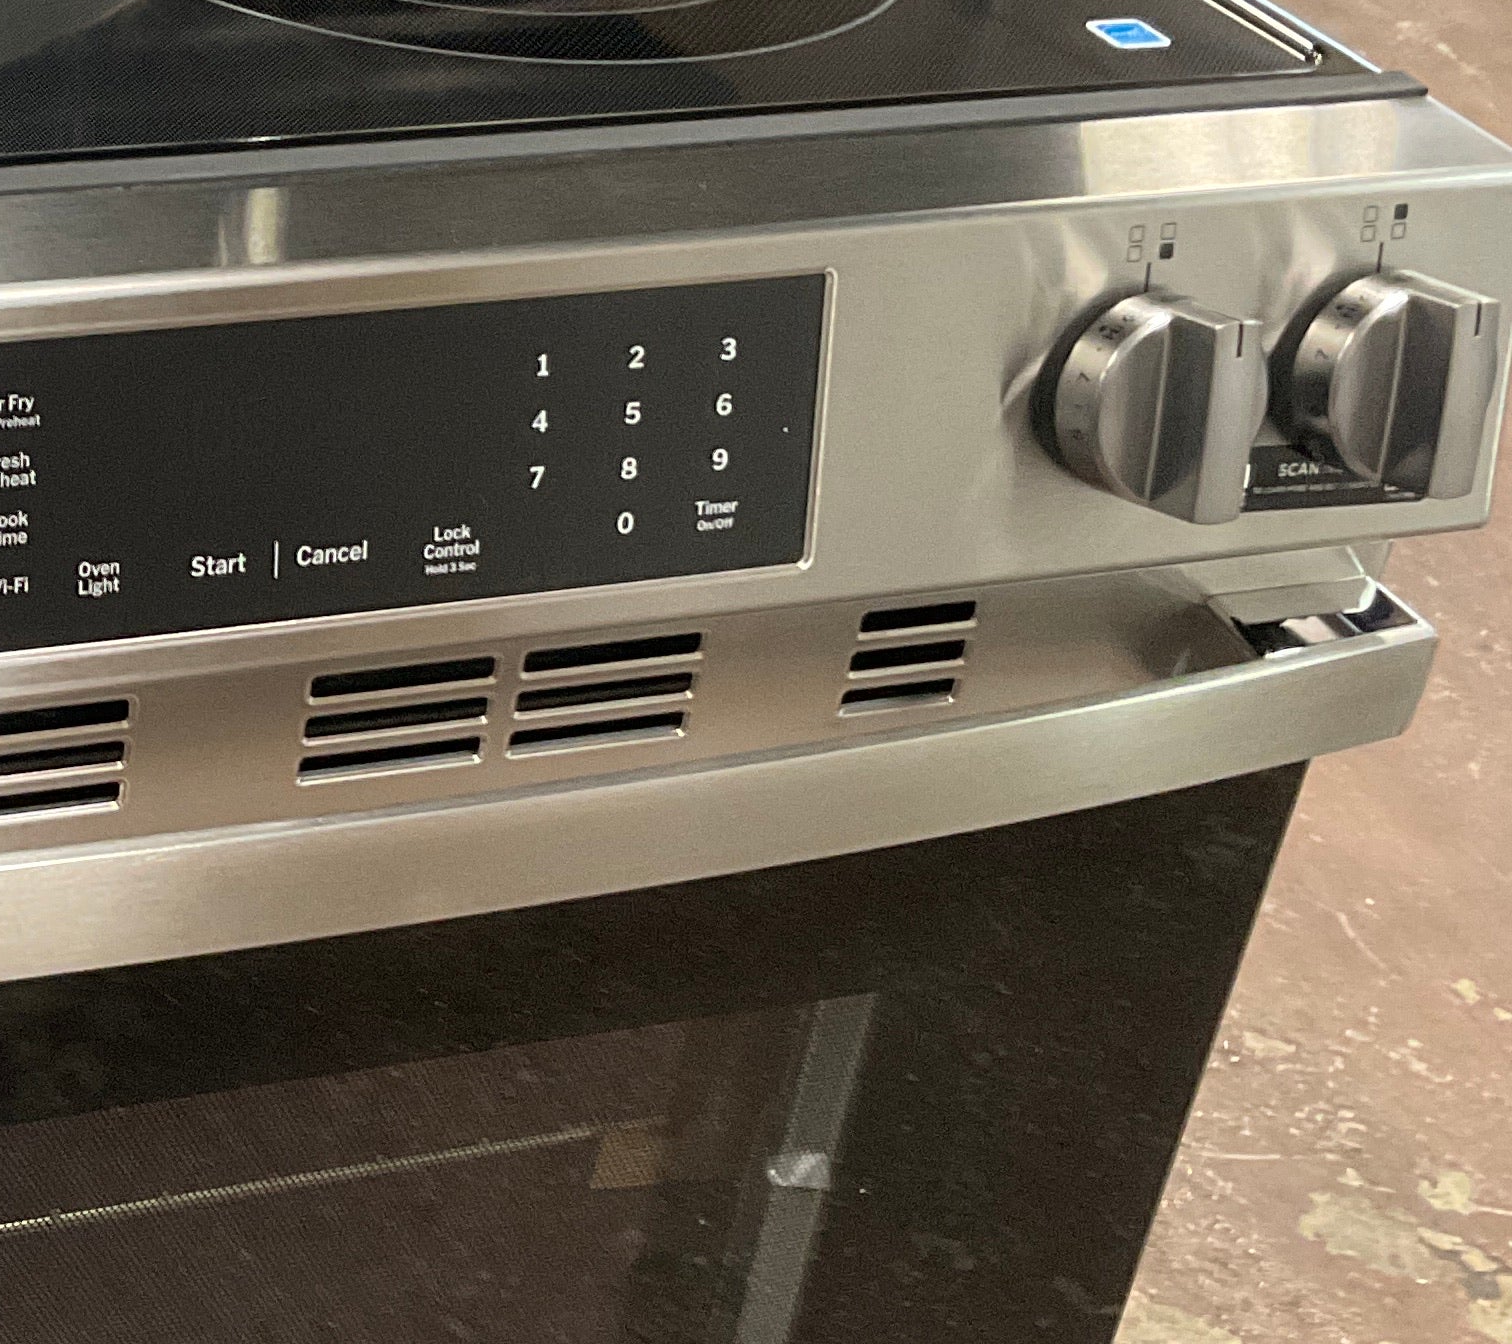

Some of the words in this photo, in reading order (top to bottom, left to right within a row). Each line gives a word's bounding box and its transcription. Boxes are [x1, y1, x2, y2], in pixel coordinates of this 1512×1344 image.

[628, 344, 646, 370] 2
[719, 337, 737, 361] 3
[536, 353, 550, 377] 1
[8, 393, 35, 413] Fry
[623, 401, 642, 425] 5
[715, 392, 733, 417] 6
[531, 409, 549, 433] 4
[620, 456, 638, 480] 8
[711, 448, 729, 472] 9
[1277, 462, 1320, 478] SCAN
[529, 465, 546, 490] 7
[694, 500, 739, 516] Timer
[433, 523, 471, 543] Lock
[616, 511, 635, 535] 0
[296, 539, 369, 567] Cancel
[423, 539, 481, 560] Control
[78, 561, 120, 578] Oven
[190, 552, 247, 578] Start
[77, 576, 120, 597] Light
